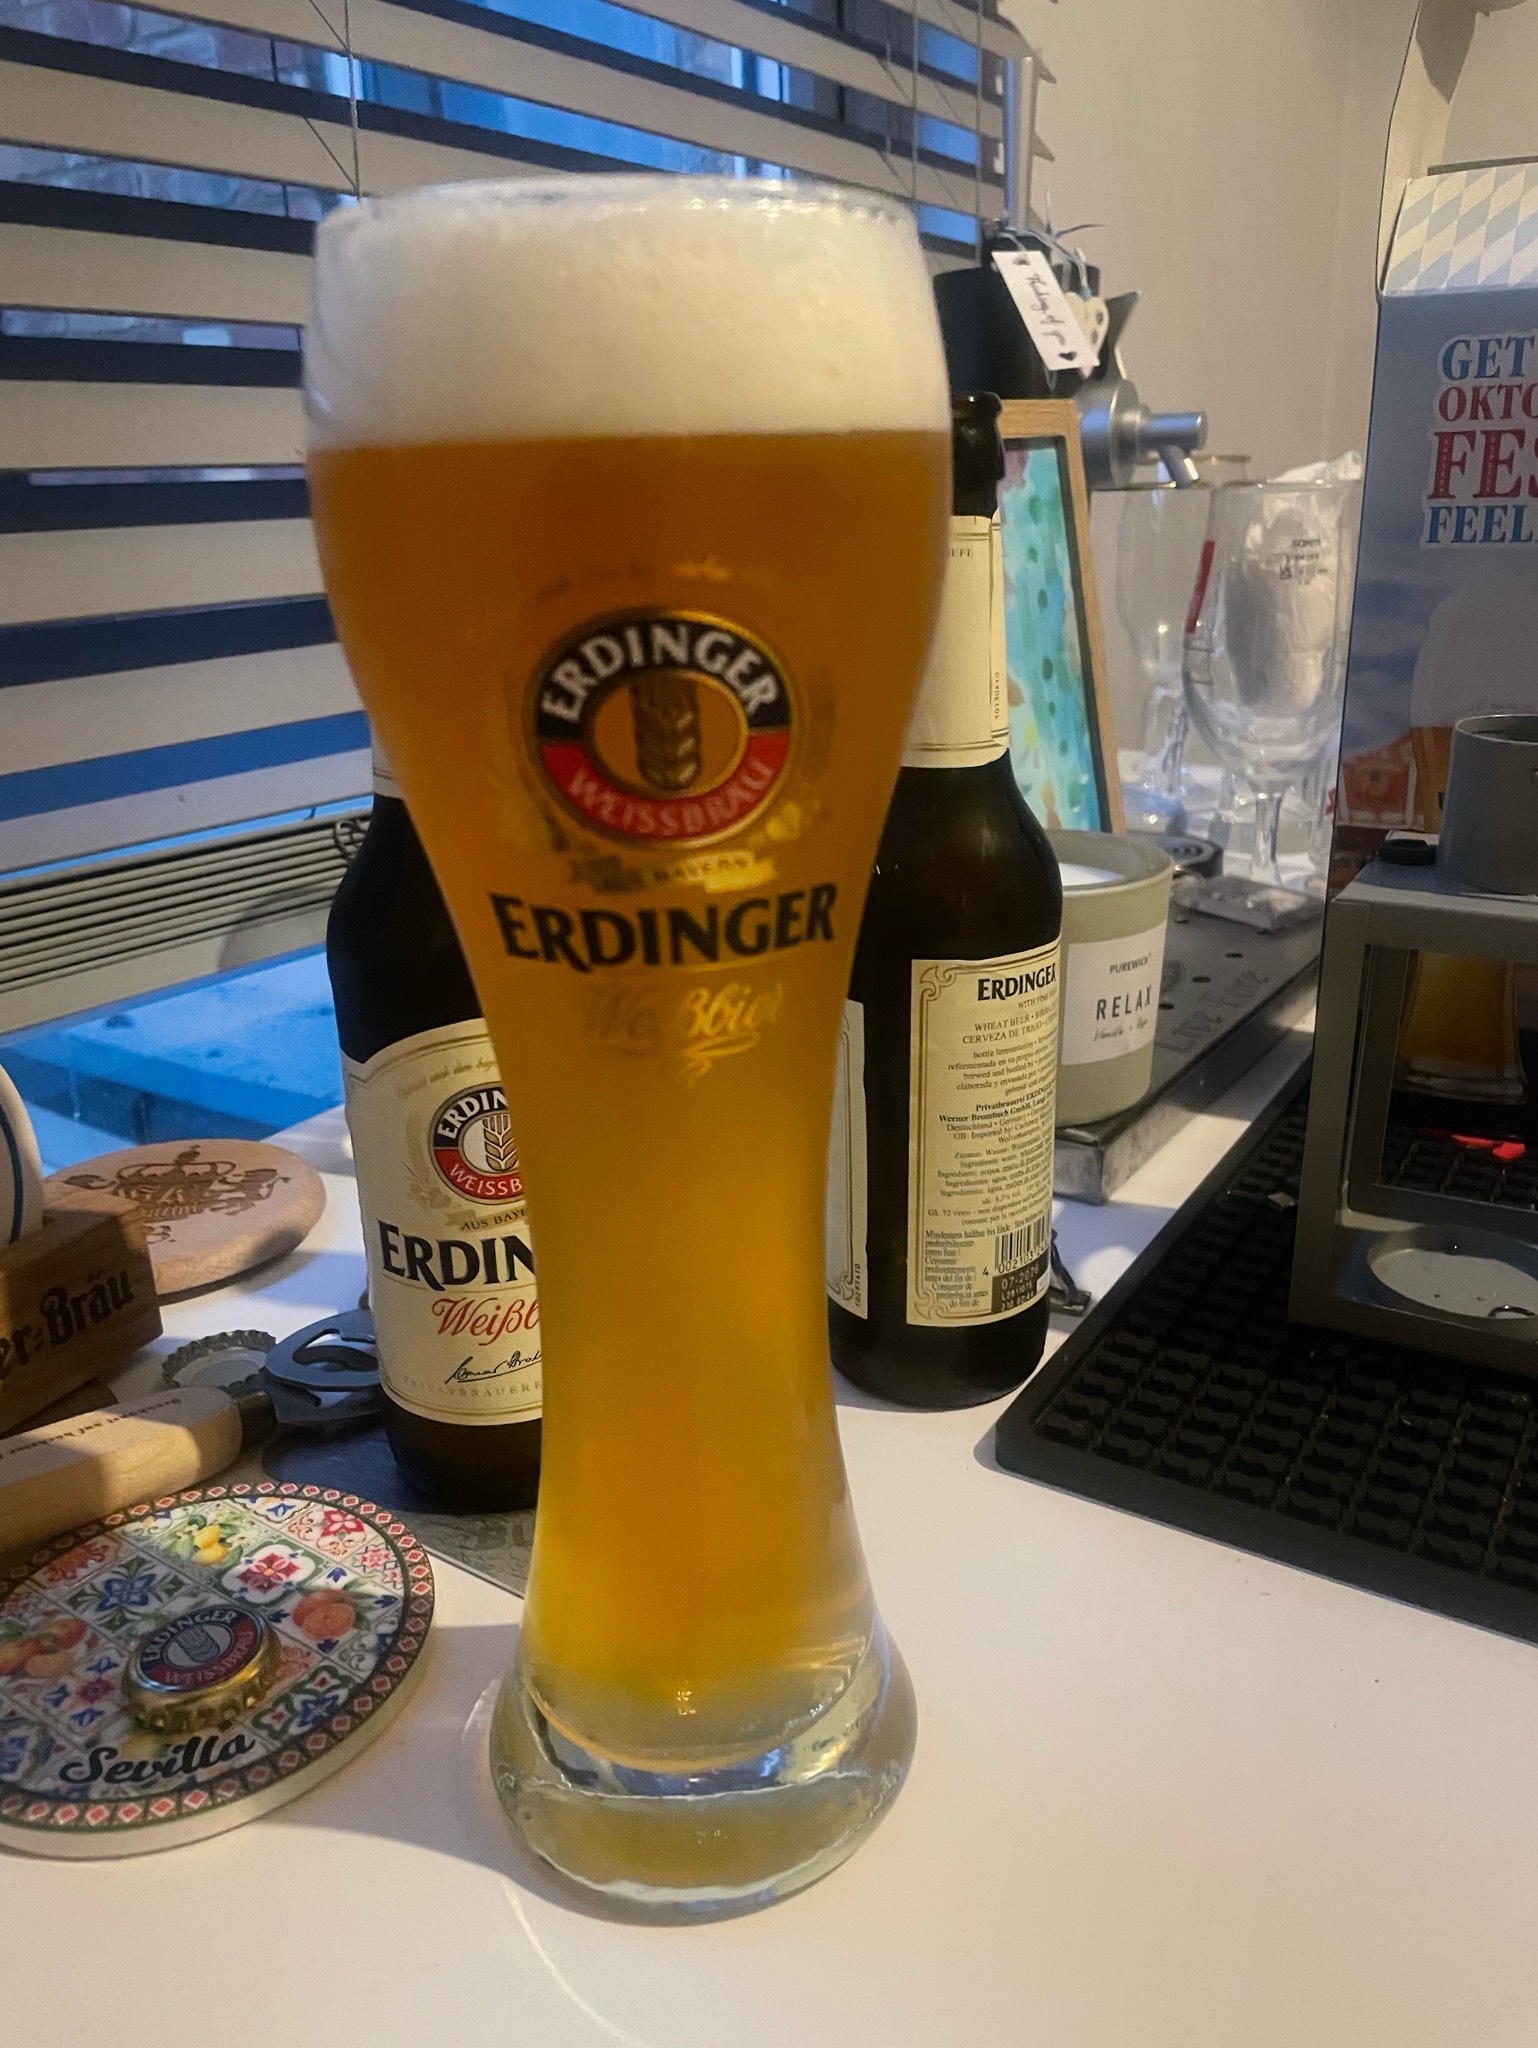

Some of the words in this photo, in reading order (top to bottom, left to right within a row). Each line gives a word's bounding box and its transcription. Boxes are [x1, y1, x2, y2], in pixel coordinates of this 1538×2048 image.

[1442, 335, 1535, 381] GET
[541, 623, 780, 723] ERDINGER
[488, 882, 837, 974] ERDINGER
[977, 962, 1057, 1001] ERDINGER
[1095, 985, 1153, 1021] RELAX
[962, 1031, 1007, 1045] CERVEZA
[1008, 1027, 1020, 1039] DE
[974, 1019, 1009, 1032] WHEAT
[1010, 1014, 1030, 1027] BEER
[973, 1047, 995, 1059] bottle
[998, 1058, 1007, 1066] en
[956, 1079, 992, 1091] elaborada
[963, 1069, 991, 1080] brewed
[437, 1090, 509, 1140] ERDIN
[938, 1113, 969, 1123] Werner
[970, 1107, 1009, 1122] Brombach
[449, 1162, 523, 1196] WEISSB
[461, 1219, 490, 1232] AUS
[377, 1218, 536, 1292] ERDIN
[982, 1266, 989, 1277] 4
[58, 1733, 256, 1785] Sevilla
